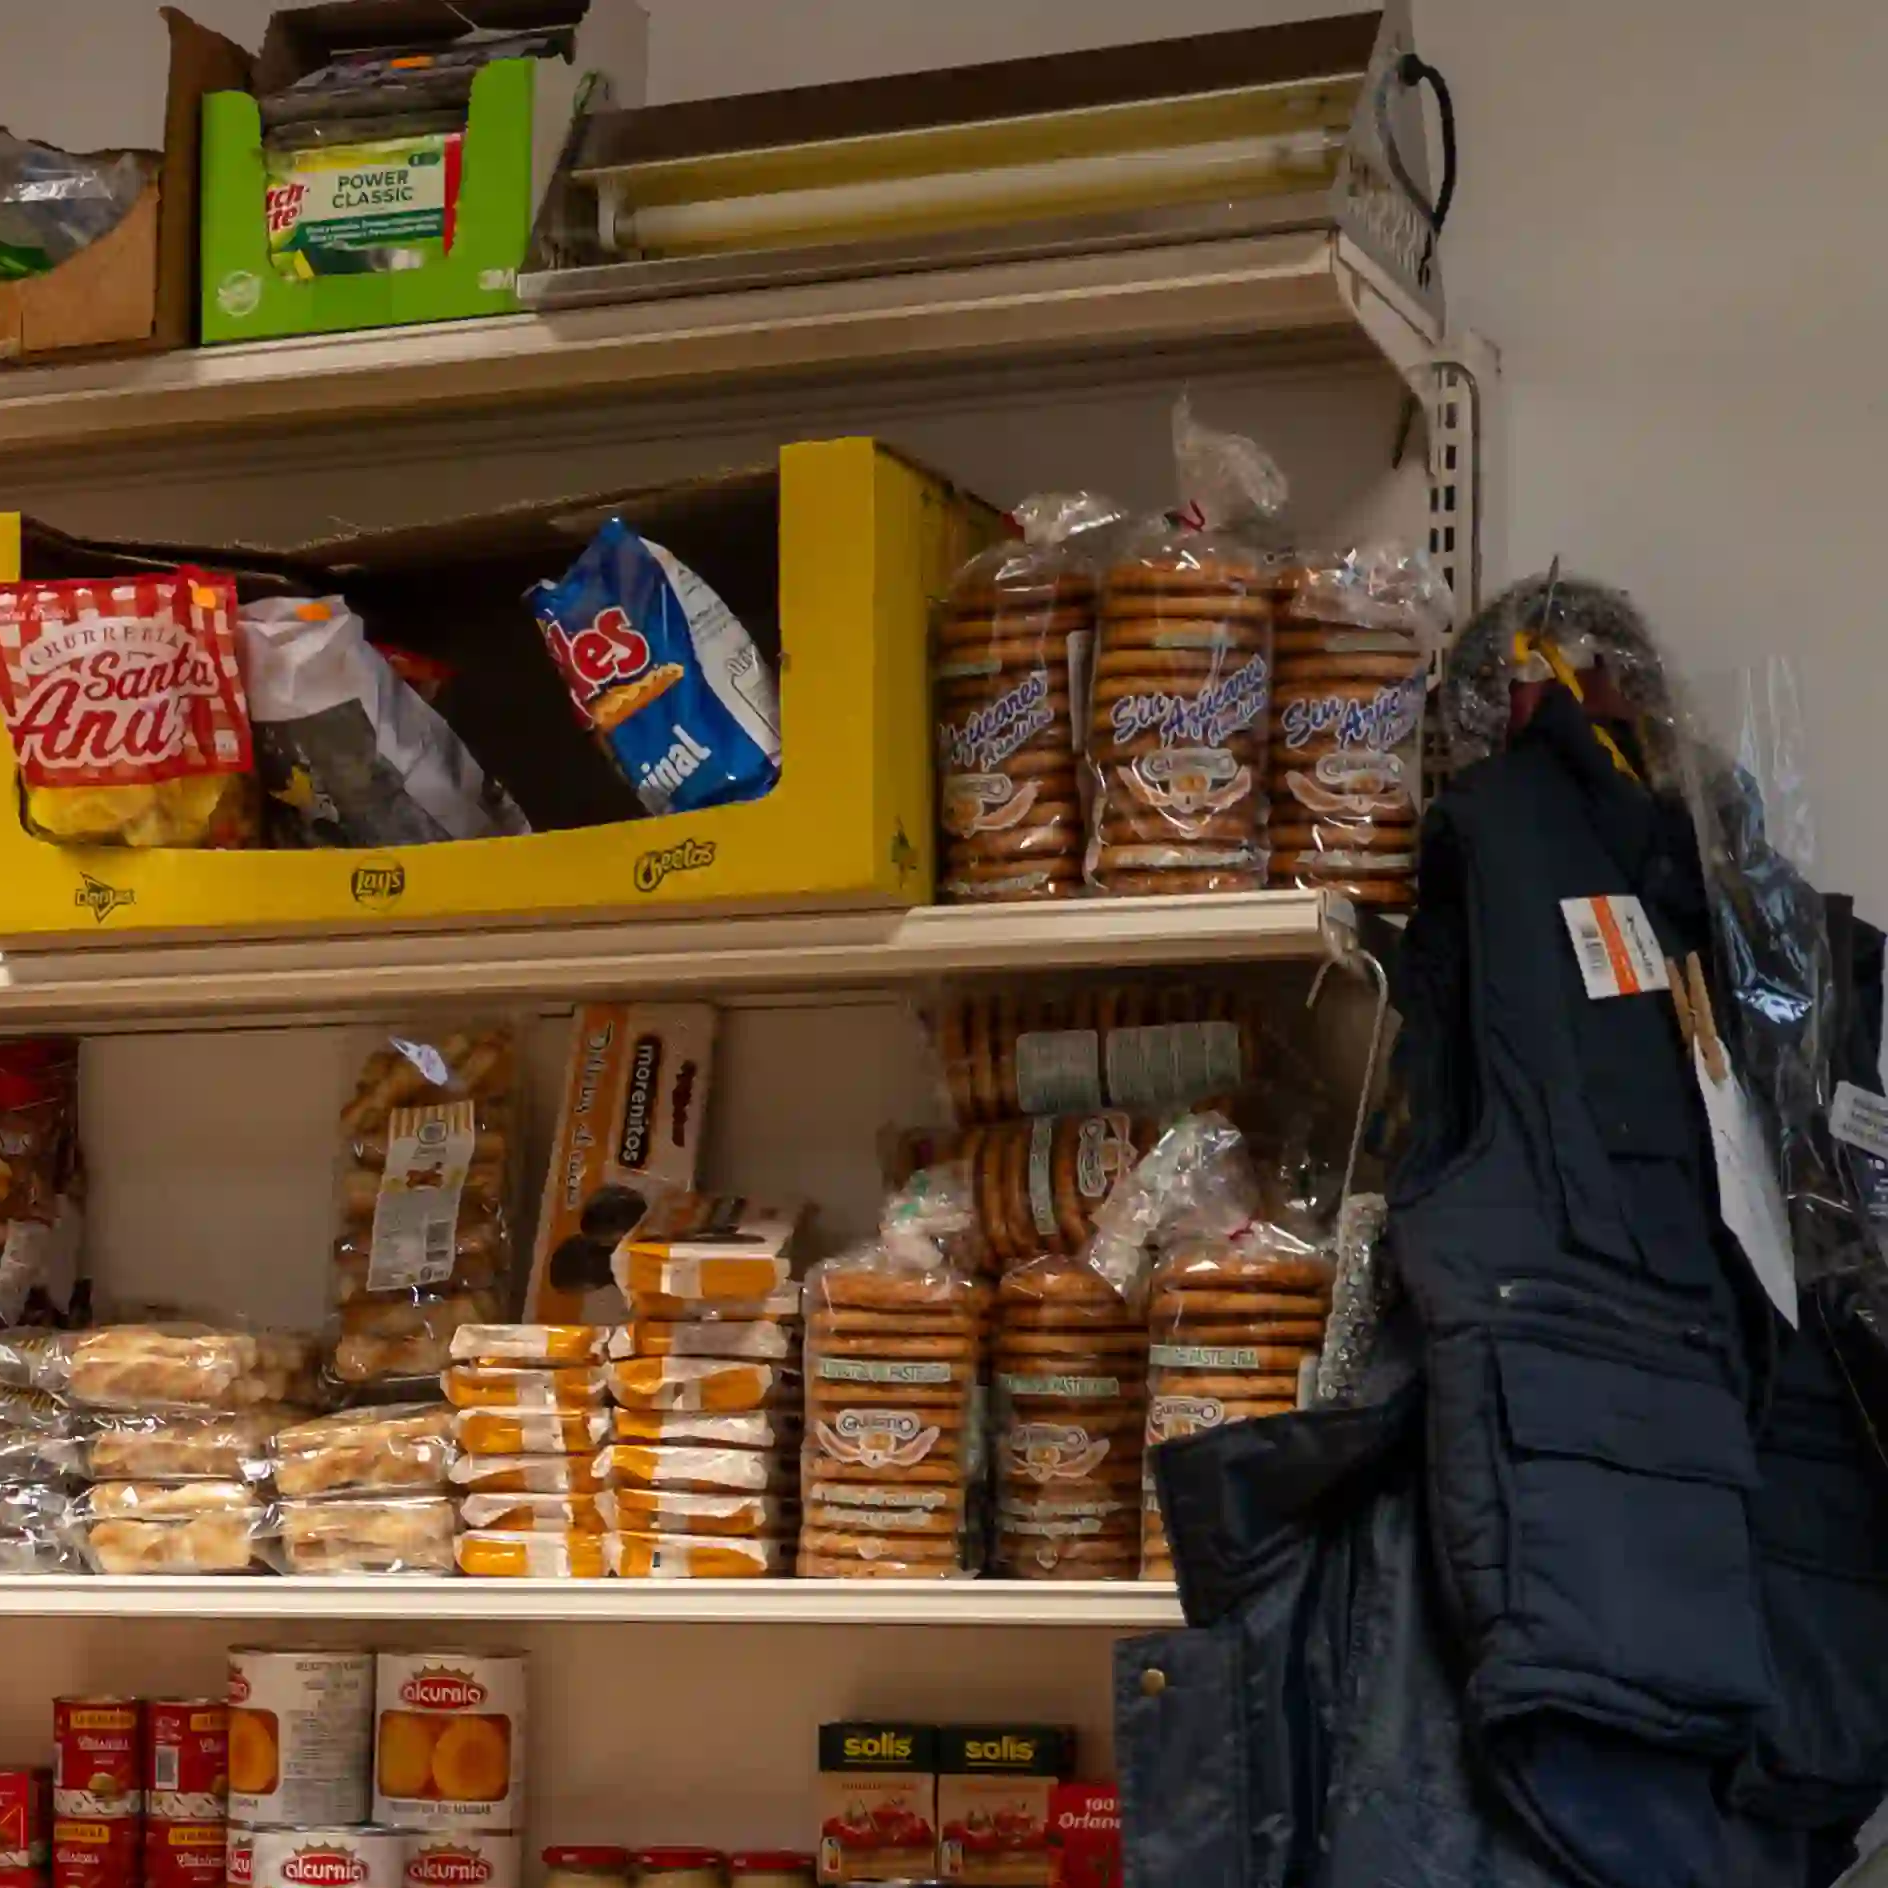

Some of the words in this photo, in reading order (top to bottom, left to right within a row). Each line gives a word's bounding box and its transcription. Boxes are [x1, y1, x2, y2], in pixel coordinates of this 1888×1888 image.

[331, 187, 414, 210] CLASSIC
[338, 170, 410, 191] POWER
[82, 646, 217, 701] Santa
[7, 679, 180, 766] Ana
[1110, 690, 1165, 743] Sin
[633, 839, 717, 892] Cheetos
[621, 1044, 654, 1163] morenitos
[1058, 1812, 1122, 1830] Orlan
[284, 1858, 365, 1882] alcurnia
